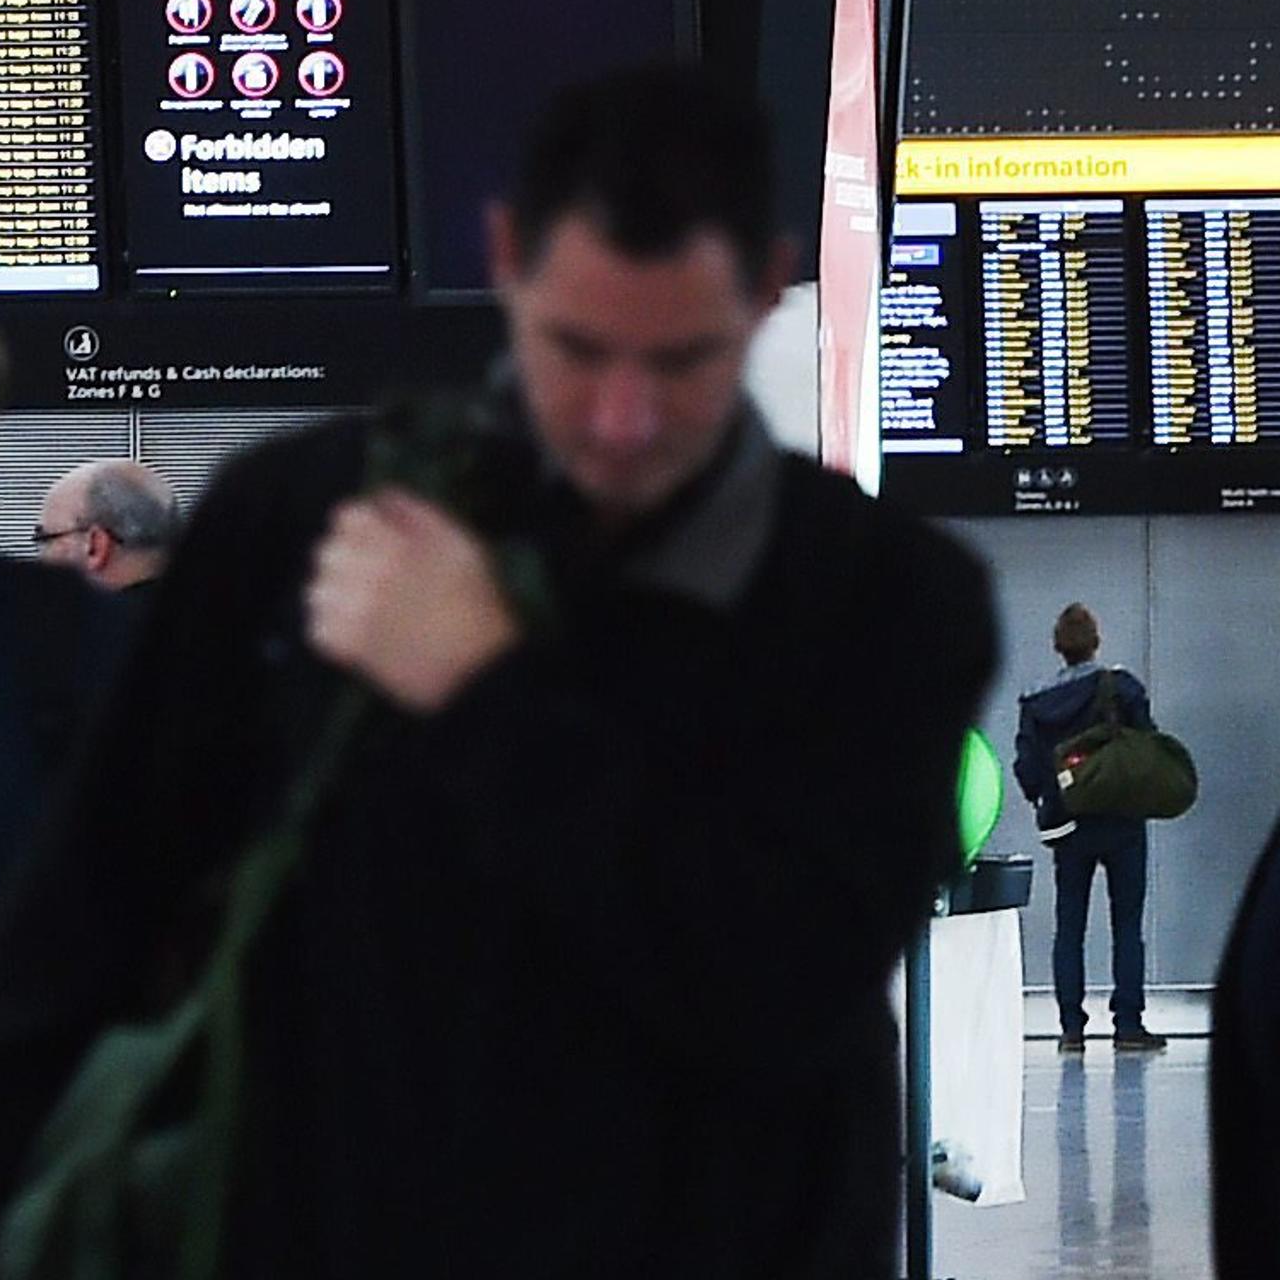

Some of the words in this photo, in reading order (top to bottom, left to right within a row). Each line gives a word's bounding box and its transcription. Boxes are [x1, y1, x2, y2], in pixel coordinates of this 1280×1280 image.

[180, 133, 325, 161] Forbidden
[969, 154, 1128, 179] information
[66, 367, 95, 382] VAT
[100, 366, 162, 381] refunds
[166, 367, 178, 380] &
[182, 366, 221, 380] Cash
[223, 365, 326, 380] declarations:
[67, 384, 115, 399] Zones
[131, 384, 144, 398] &
[148, 384, 162, 398] G
